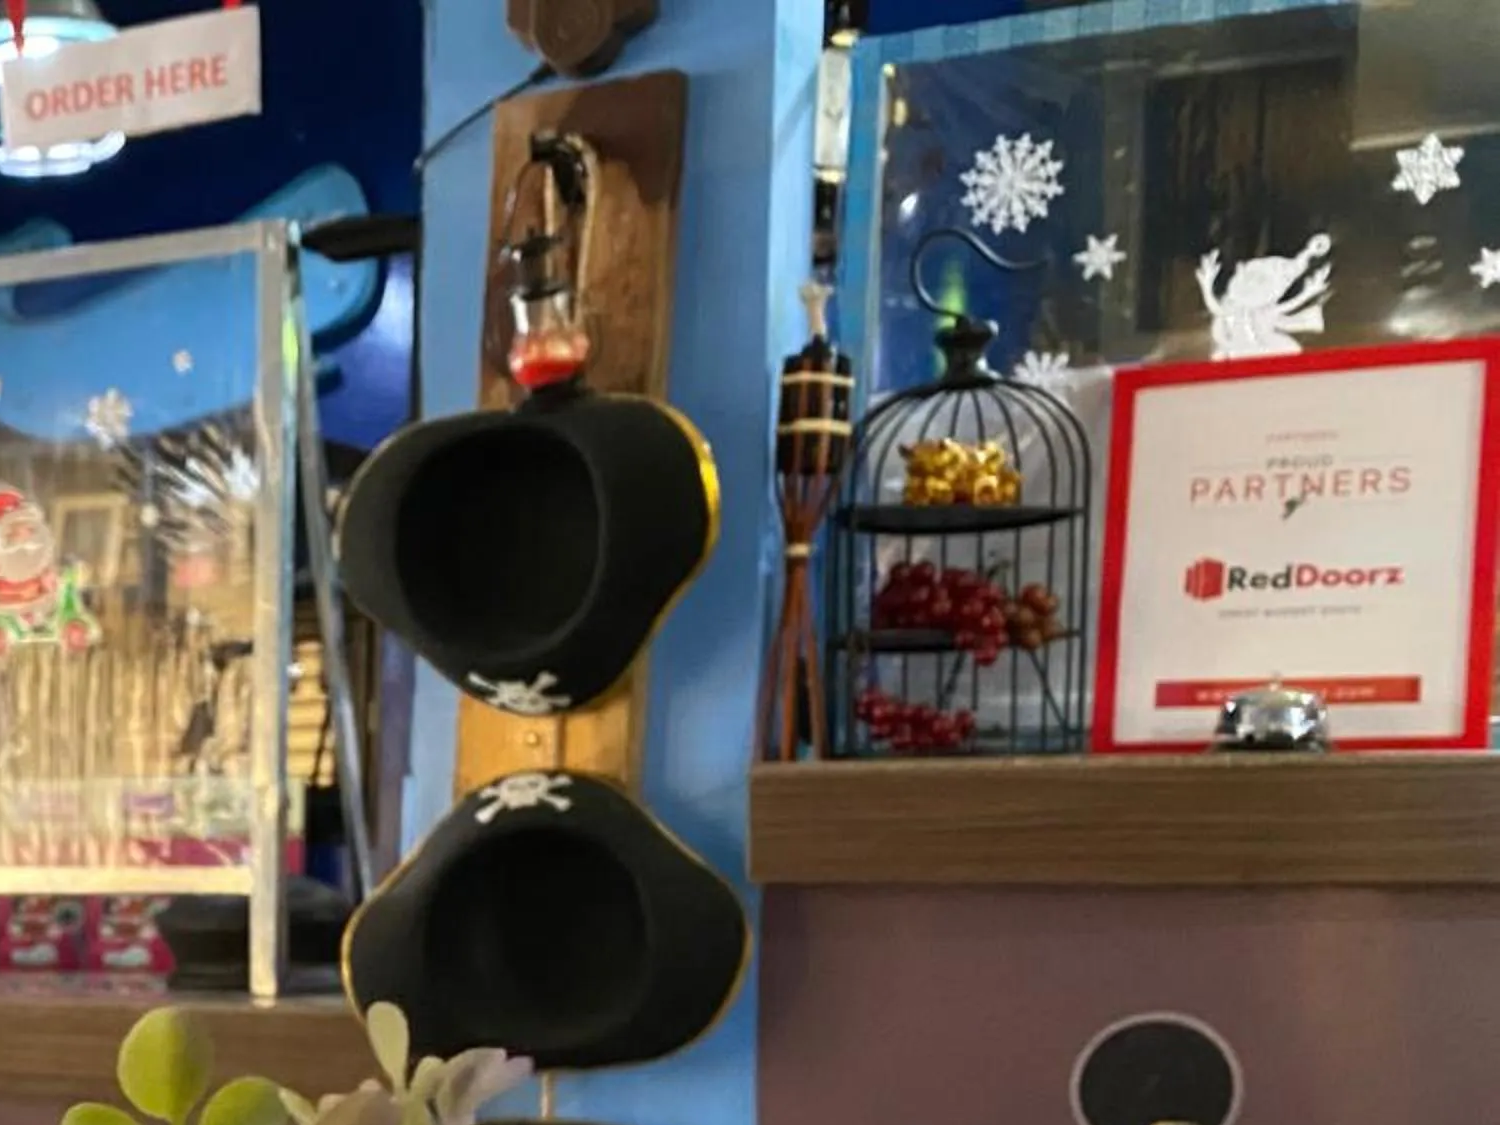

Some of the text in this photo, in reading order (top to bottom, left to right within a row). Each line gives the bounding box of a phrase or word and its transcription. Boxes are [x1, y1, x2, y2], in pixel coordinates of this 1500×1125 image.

[25, 56, 226, 120] ORDER HERE
[1189, 467, 1412, 502] PARTNERS
[1227, 563, 1404, 592] RedDoorz
